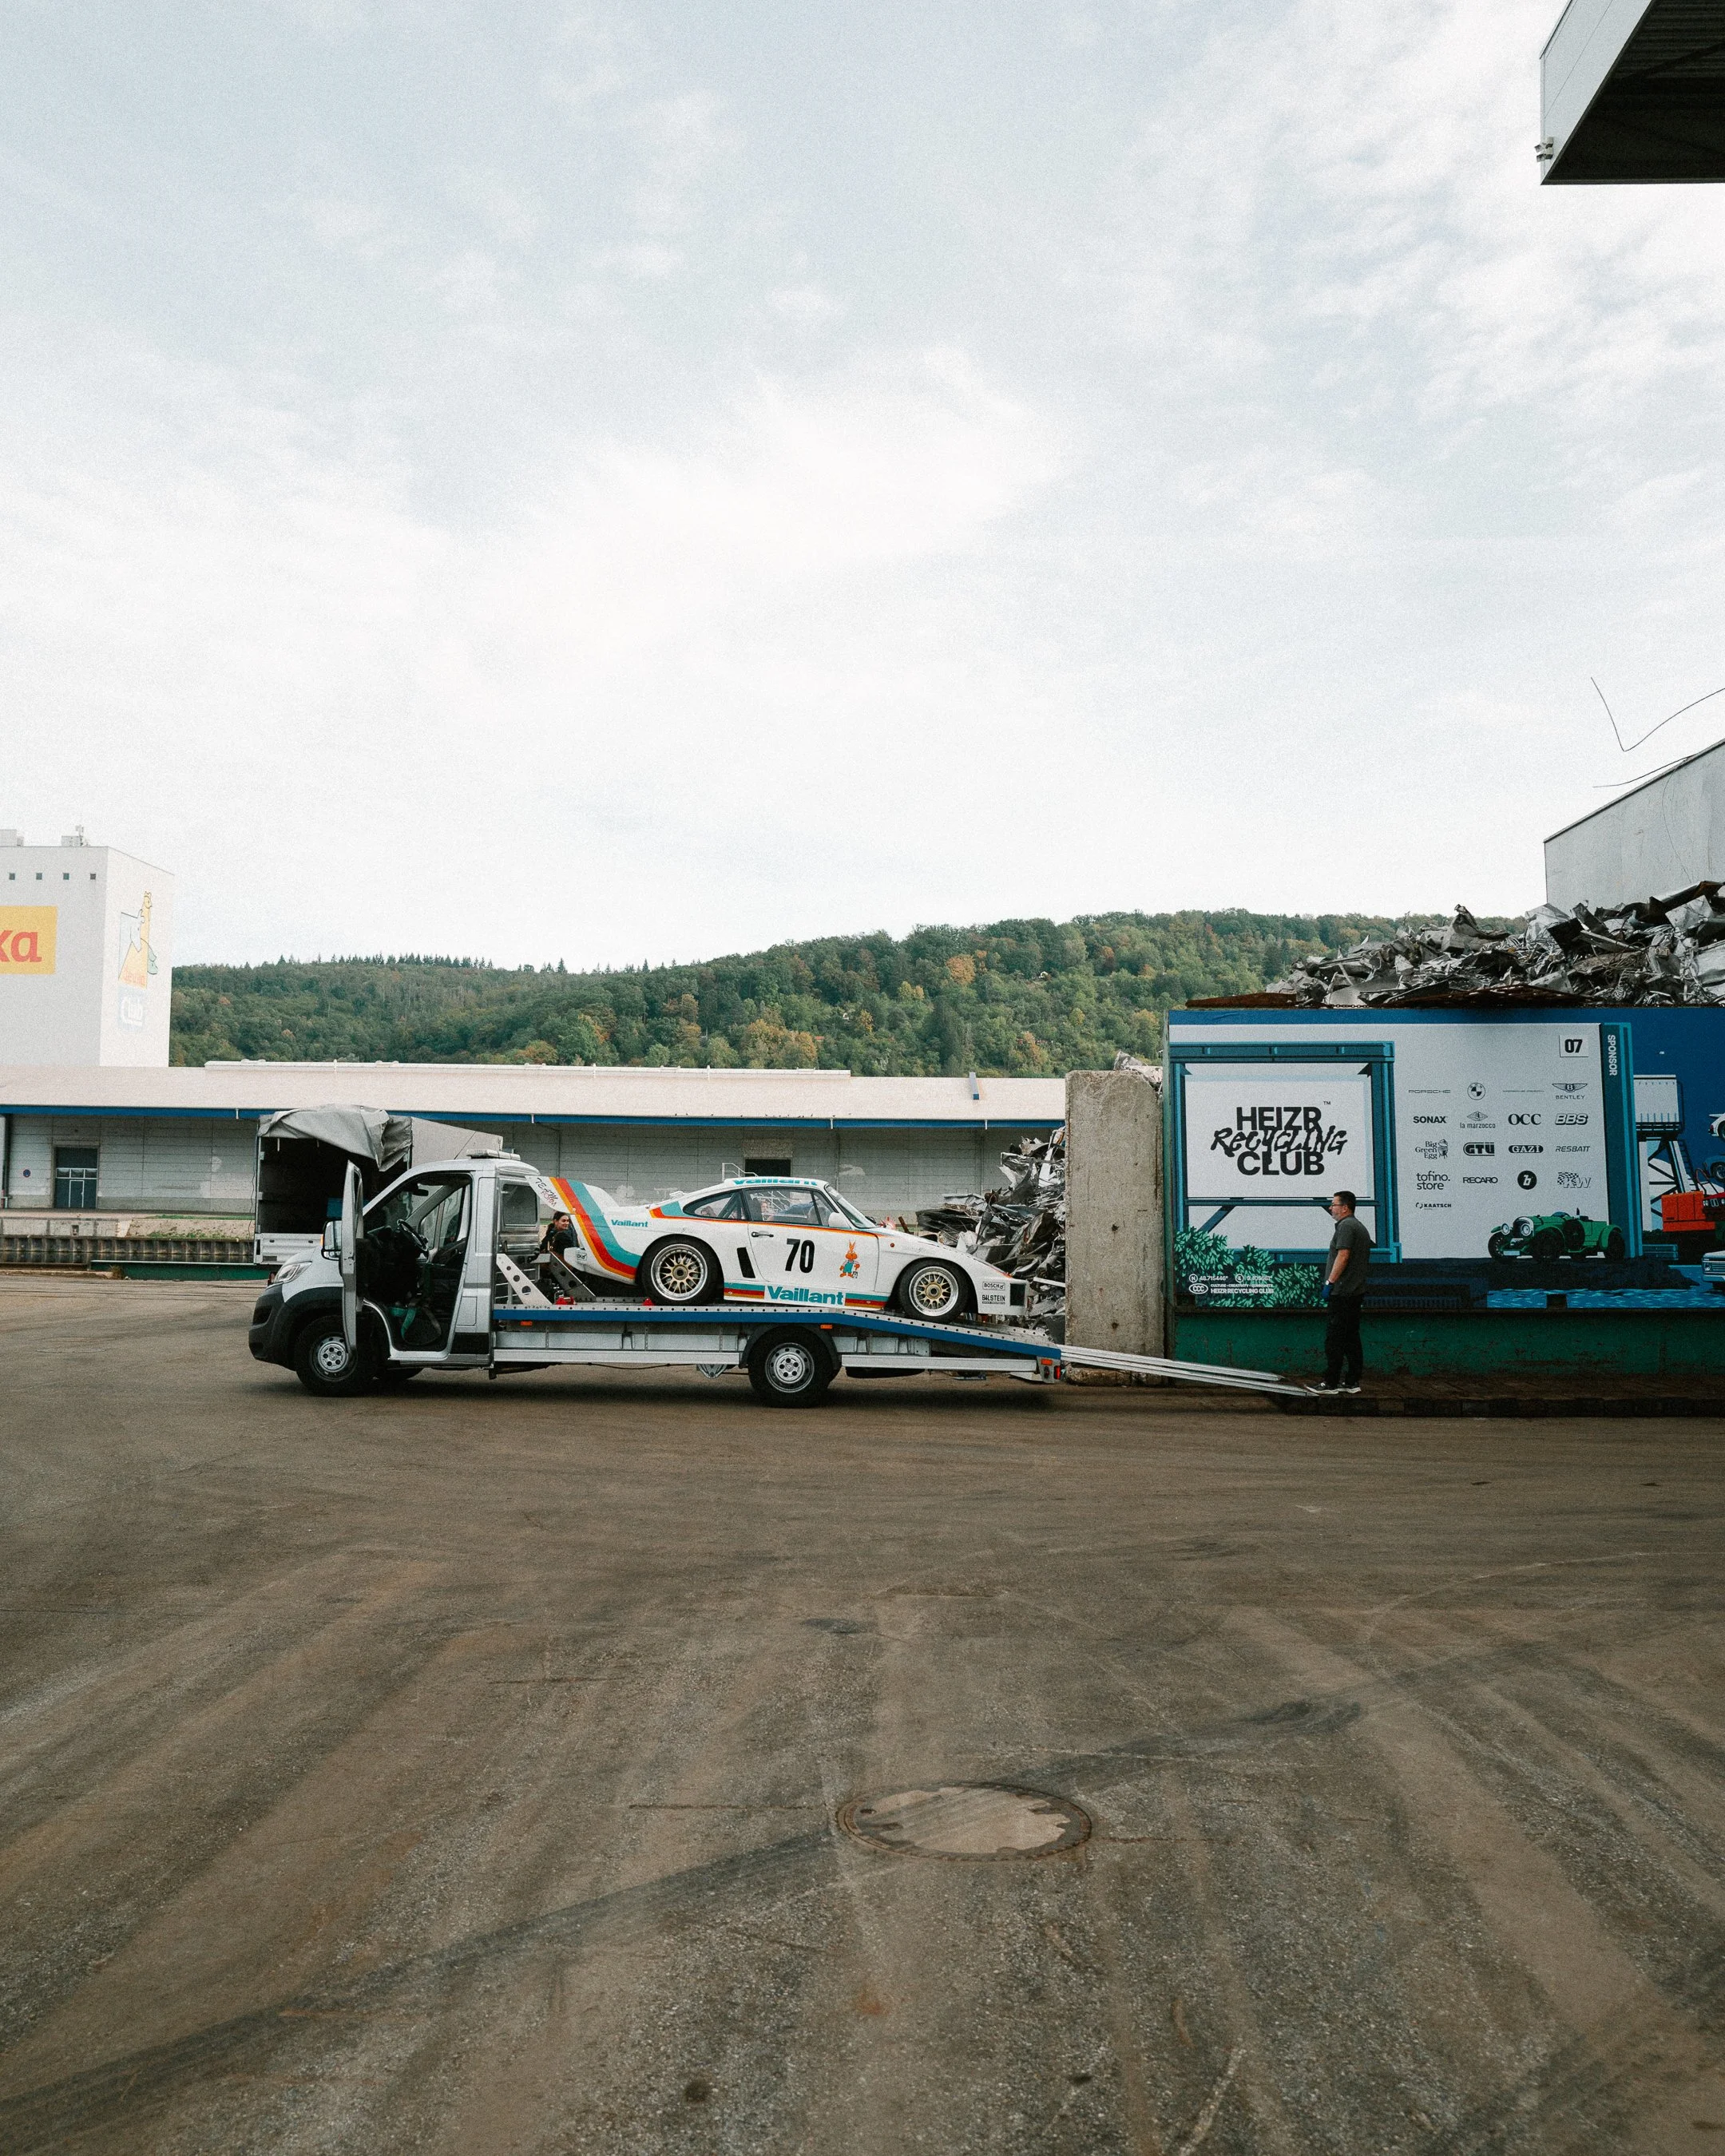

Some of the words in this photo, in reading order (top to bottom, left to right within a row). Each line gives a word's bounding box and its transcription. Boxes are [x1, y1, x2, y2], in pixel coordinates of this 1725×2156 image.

[1564, 1039, 1583, 1053] 07
[1607, 1034, 1618, 1076] SPONSOR
[1236, 1107, 1322, 1131] HEIZR
[1508, 1113, 1542, 1126] OCC
[1555, 1113, 1588, 1125] BBS
[1237, 1151, 1325, 1176] CLUB
[1416, 1171, 1451, 1182] tofino.
[611, 1219, 648, 1228] Vaillant
[785, 1238, 815, 1274] 70
[767, 1285, 844, 1306] Vaillant
